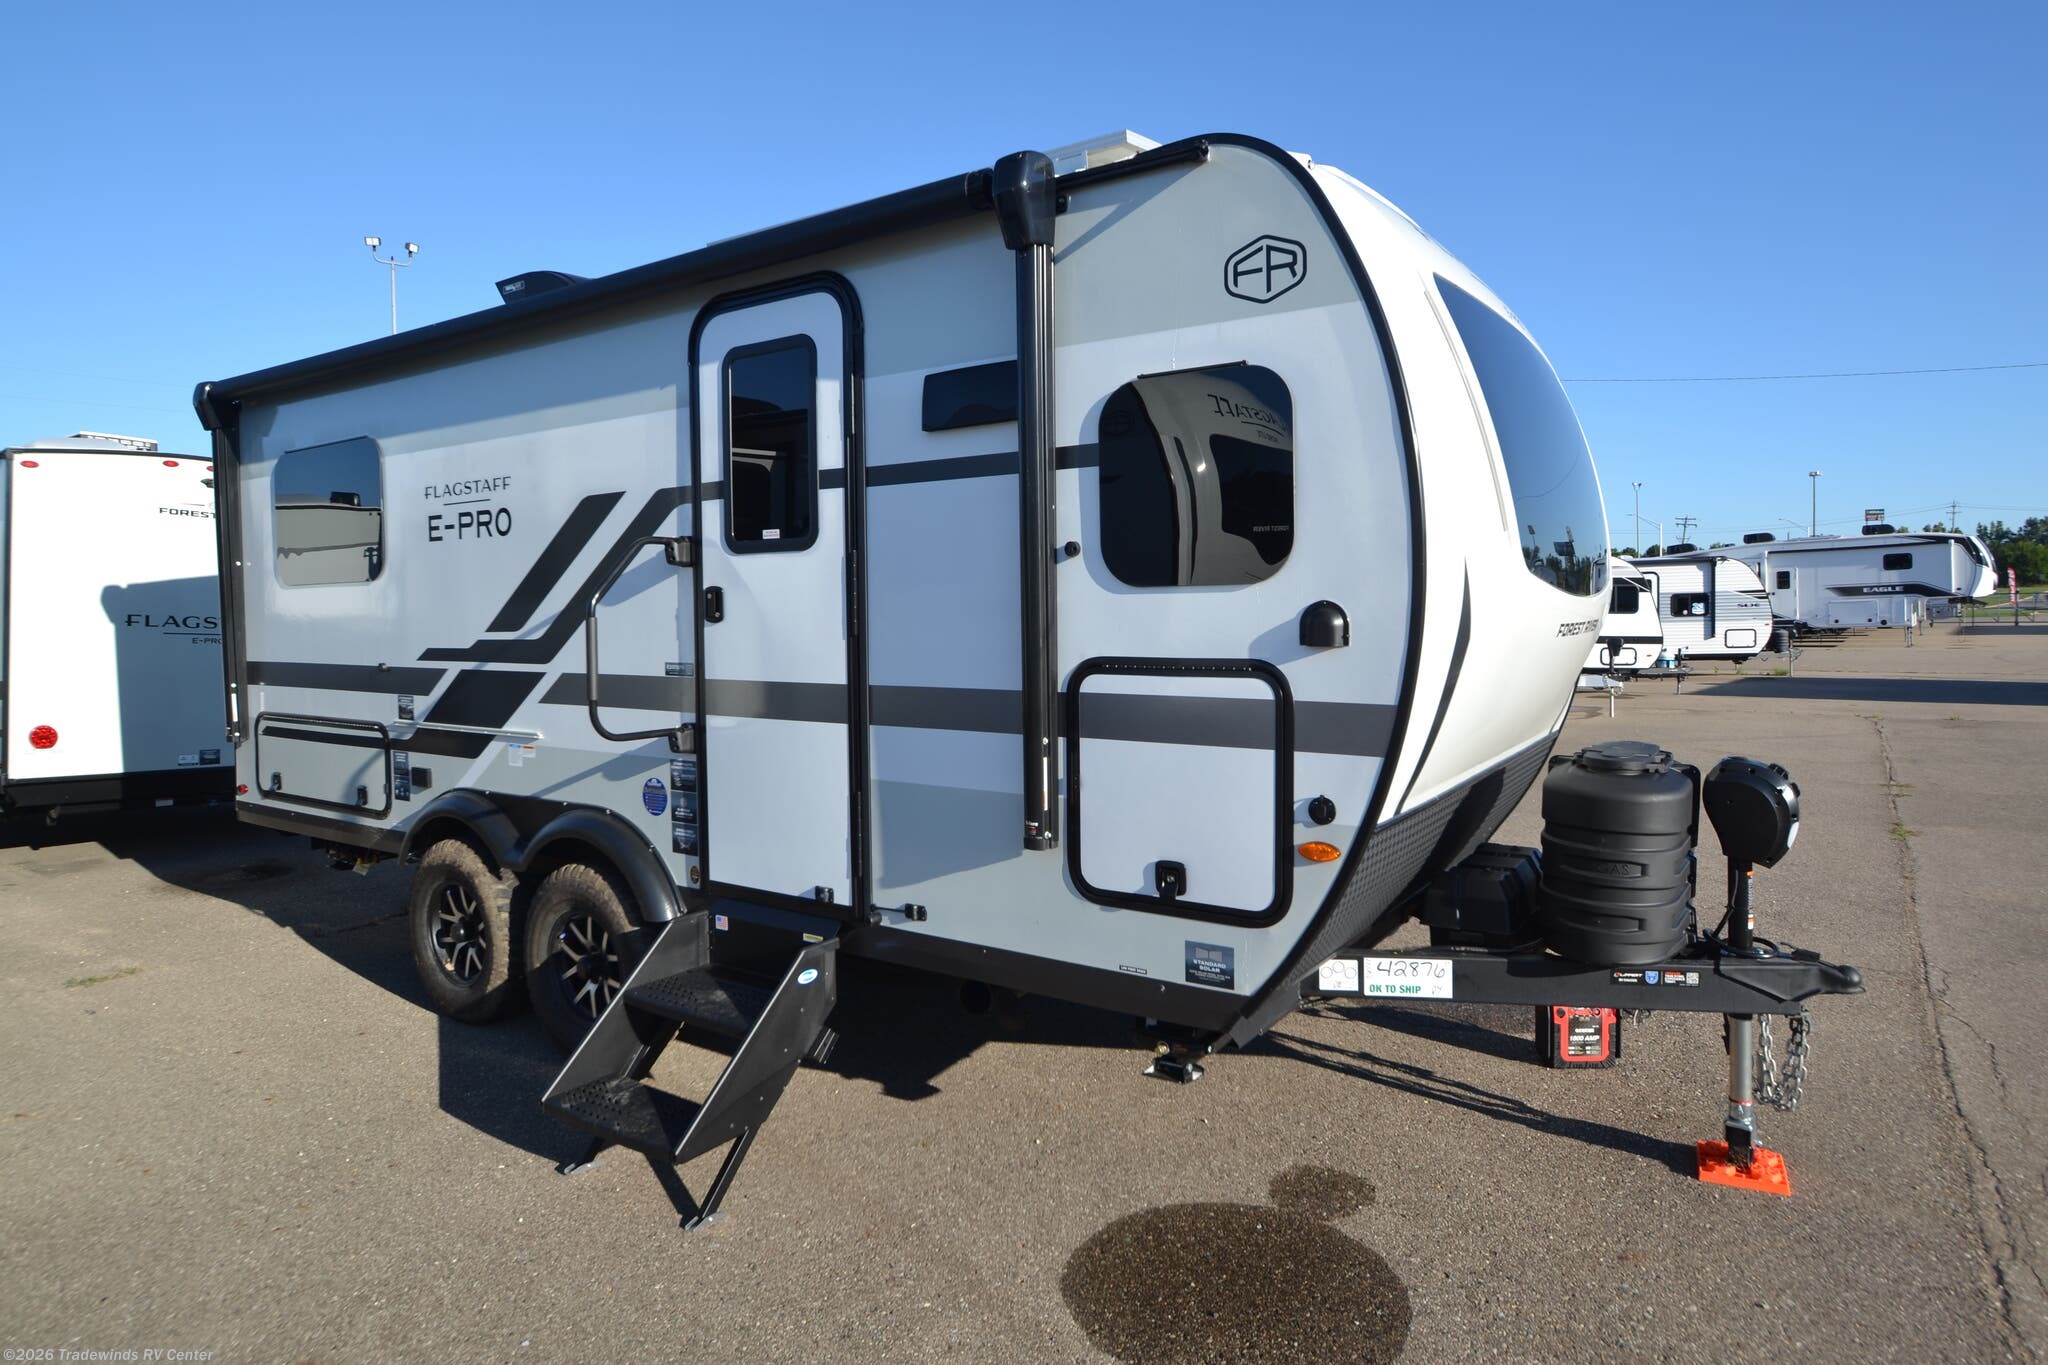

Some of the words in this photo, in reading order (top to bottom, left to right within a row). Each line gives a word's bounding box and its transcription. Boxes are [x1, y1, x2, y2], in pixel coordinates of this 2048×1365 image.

[1233, 244, 1298, 294] FR
[424, 476, 511, 500] FLAGSTAFF
[428, 507, 512, 542] E-PRO
[1863, 585, 1905, 593] EAGLE
[125, 614, 219, 630] FLAGS
[1556, 621, 1586, 638] FOREST
[1193, 959, 1227, 969] STANDARD
[1377, 960, 1446, 979] 42876
[1369, 984, 1382, 993] OK
[1385, 984, 1396, 993] TO
[1399, 985, 1421, 994] SHIP
